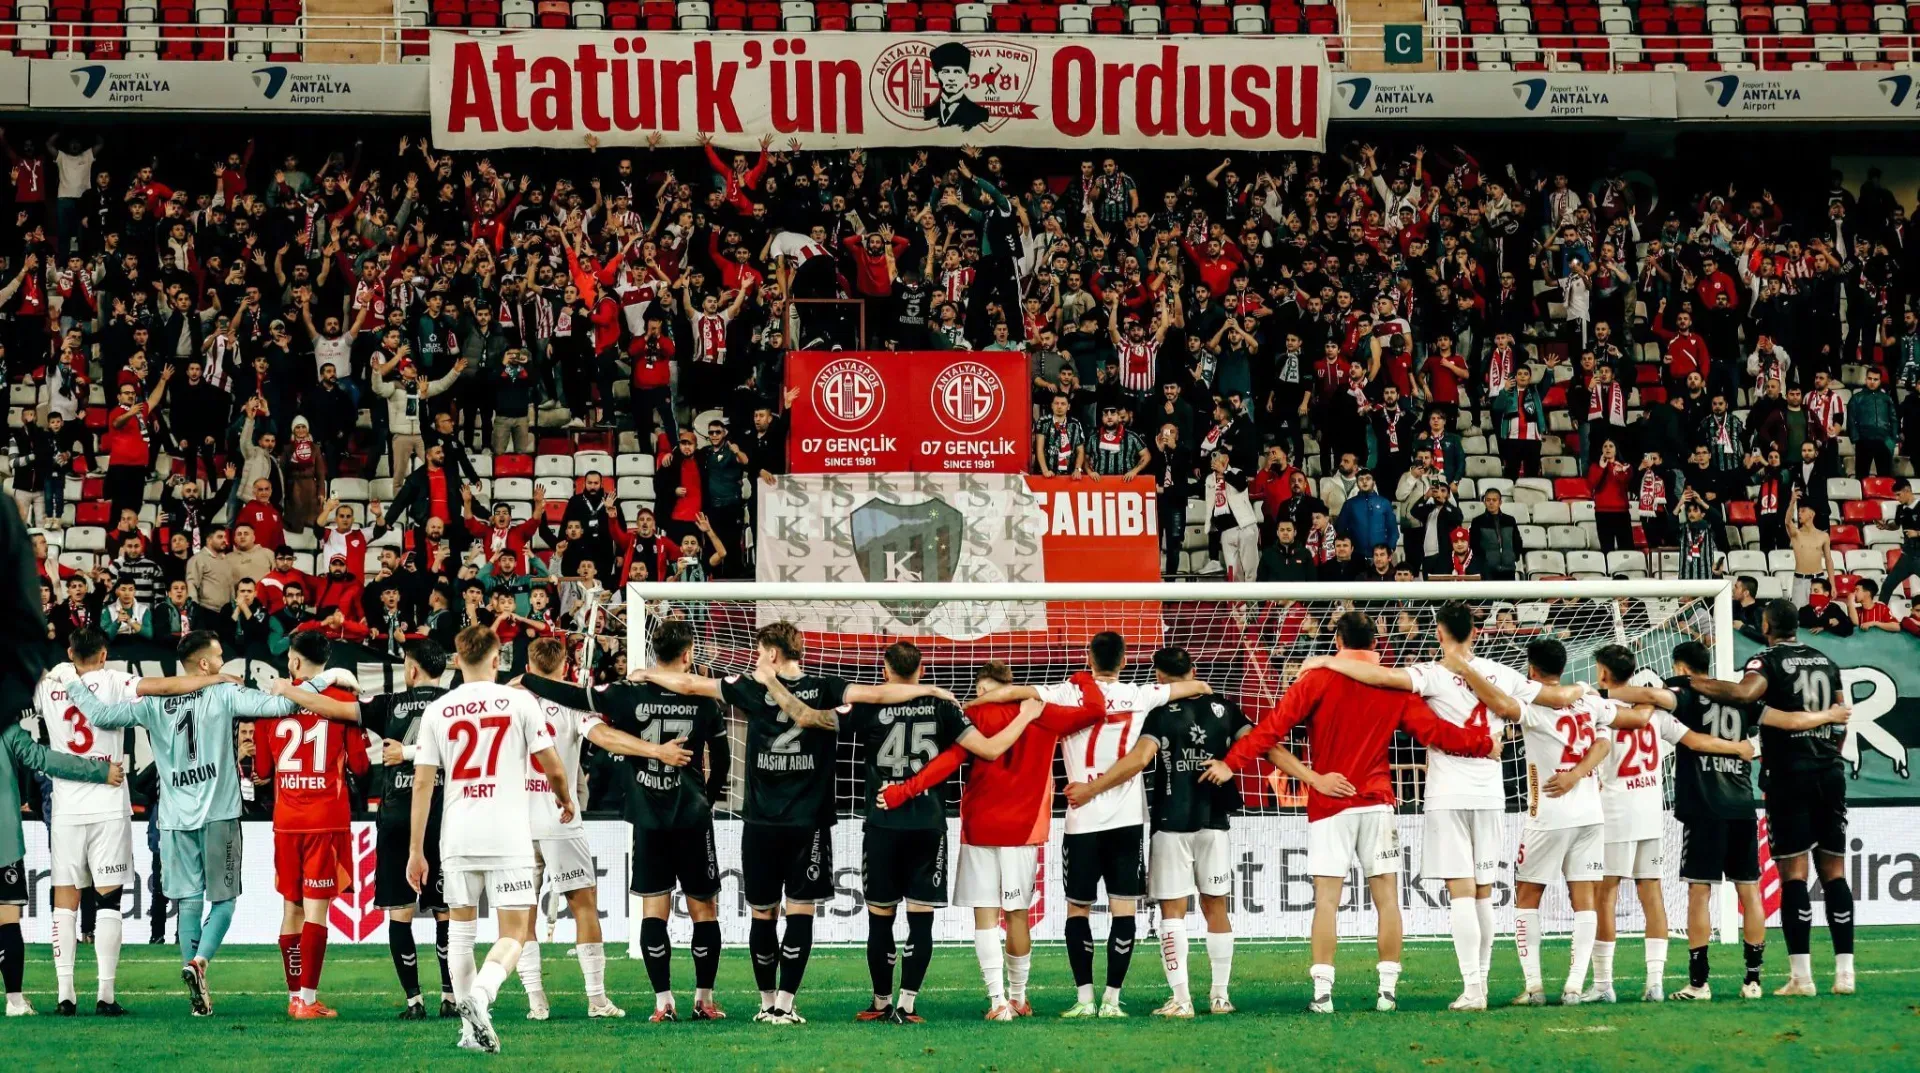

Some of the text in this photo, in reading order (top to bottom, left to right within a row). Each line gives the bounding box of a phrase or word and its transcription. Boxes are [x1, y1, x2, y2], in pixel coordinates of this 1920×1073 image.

[1395, 33, 1411, 54] C
[996, 50, 1029, 63] NORD
[109, 81, 170, 92] ANTALYA
[290, 82, 351, 93] ANTALYA
[1052, 45, 1319, 139] Ordusu
[109, 93, 144, 102] Airport
[290, 94, 325, 104] Airport
[1375, 93, 1434, 104] ANTALYA
[1550, 93, 1609, 104] ANTALYA
[1743, 89, 1801, 100] ANTALYA
[1375, 104, 1408, 114] Airport
[1550, 105, 1584, 115] Airport
[1743, 101, 1776, 111] Airport
[816, 361, 880, 389] ANTALYASPOR
[936, 365, 999, 391] ANTALYASPOR
[801, 433, 897, 457] 07 GENÇLİK
[921, 437, 1016, 459] 07 GENÇLİK
[824, 457, 876, 466] SINCE 1981
[943, 460, 995, 469] SINCE 1981
[1793, 669, 1831, 712] 10
[442, 700, 488, 718] anex
[642, 703, 698, 716] AUTOPORT
[886, 704, 935, 717] AUTOPORT
[63, 704, 94, 754] 3
[1702, 702, 1742, 743] 19
[175, 708, 197, 761] 1
[1555, 712, 1597, 763] 25
[275, 717, 328, 773] 21
[447, 714, 512, 782] 27
[641, 718, 694, 773] 17
[876, 721, 939, 778] 45
[1616, 723, 1659, 778] 29
[789, 753, 815, 770] ARDA
[172, 762, 217, 787] HARUN
[1626, 775, 1657, 790] HASAN
[463, 784, 496, 799] MERT
[811, 829, 821, 863] ALTINTEL
[105, 864, 128, 874] PASHA
[561, 868, 585, 881] PASHA
[309, 878, 334, 888] PASHA
[504, 879, 533, 892] PASHA
